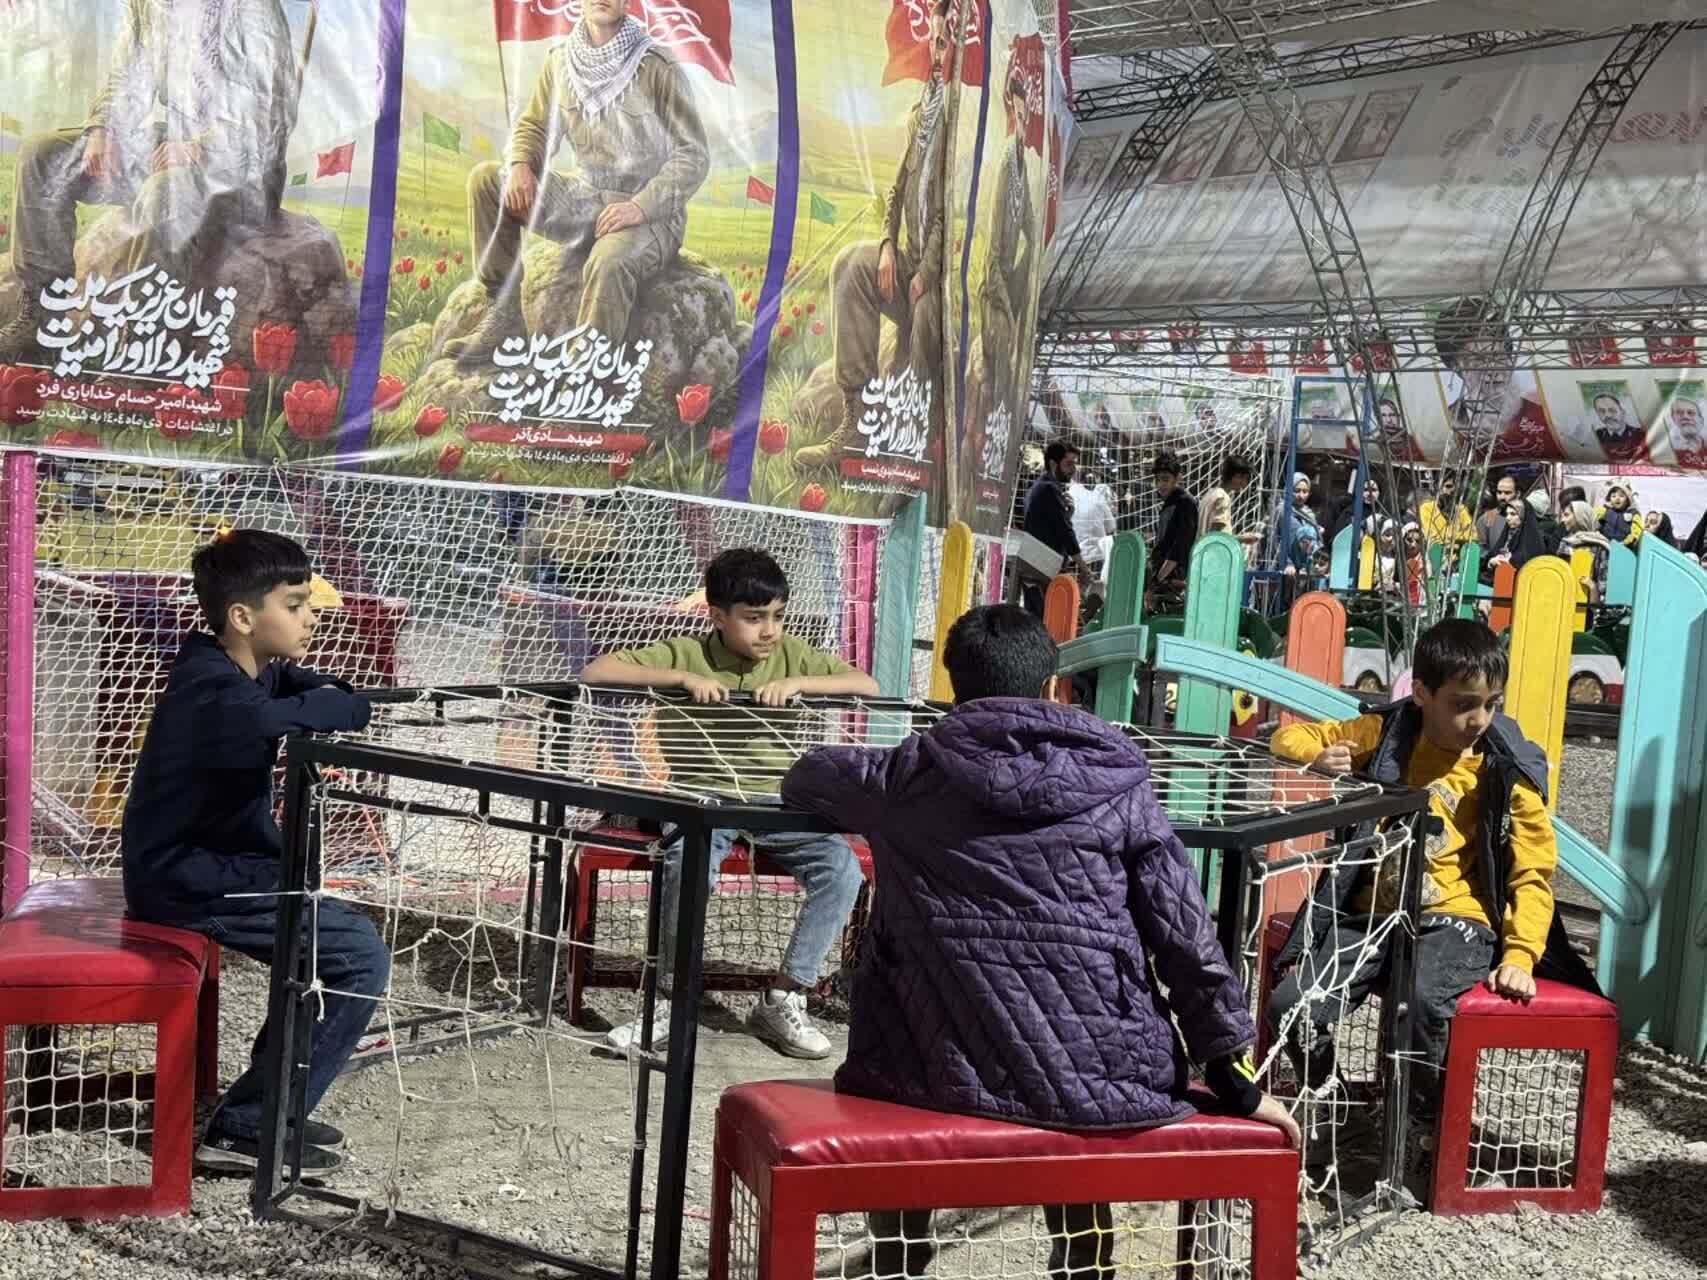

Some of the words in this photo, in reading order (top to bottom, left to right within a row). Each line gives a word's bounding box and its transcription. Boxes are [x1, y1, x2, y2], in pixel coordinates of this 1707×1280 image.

[40, 271, 106, 311] ملت
[91, 263, 157, 327] یک
[126, 270, 186, 336] عزیز
[164, 286, 238, 337] قهرمان
[36, 317, 119, 377] امنیت
[103, 329, 181, 374] دلاور
[166, 325, 231, 388] شهید
[493, 331, 548, 366] ملت
[533, 320, 591, 379] یک
[562, 328, 612, 385] عزیز
[592, 339, 653, 384] قهرمان
[36, 379, 60, 397] فرد
[61, 383, 115, 400] خدایاری
[116, 387, 156, 407] حسام
[155, 396, 186, 410] امیر
[186, 398, 222, 414] شهید
[488, 371, 555, 423] امنیت
[539, 379, 603, 418] دلاور
[588, 373, 642, 428] شهید
[46, 404, 88, 421] شهادت
[125, 413, 143, 424] ماه
[143, 418, 161, 429] دی
[575, 433, 604, 446] شهید
